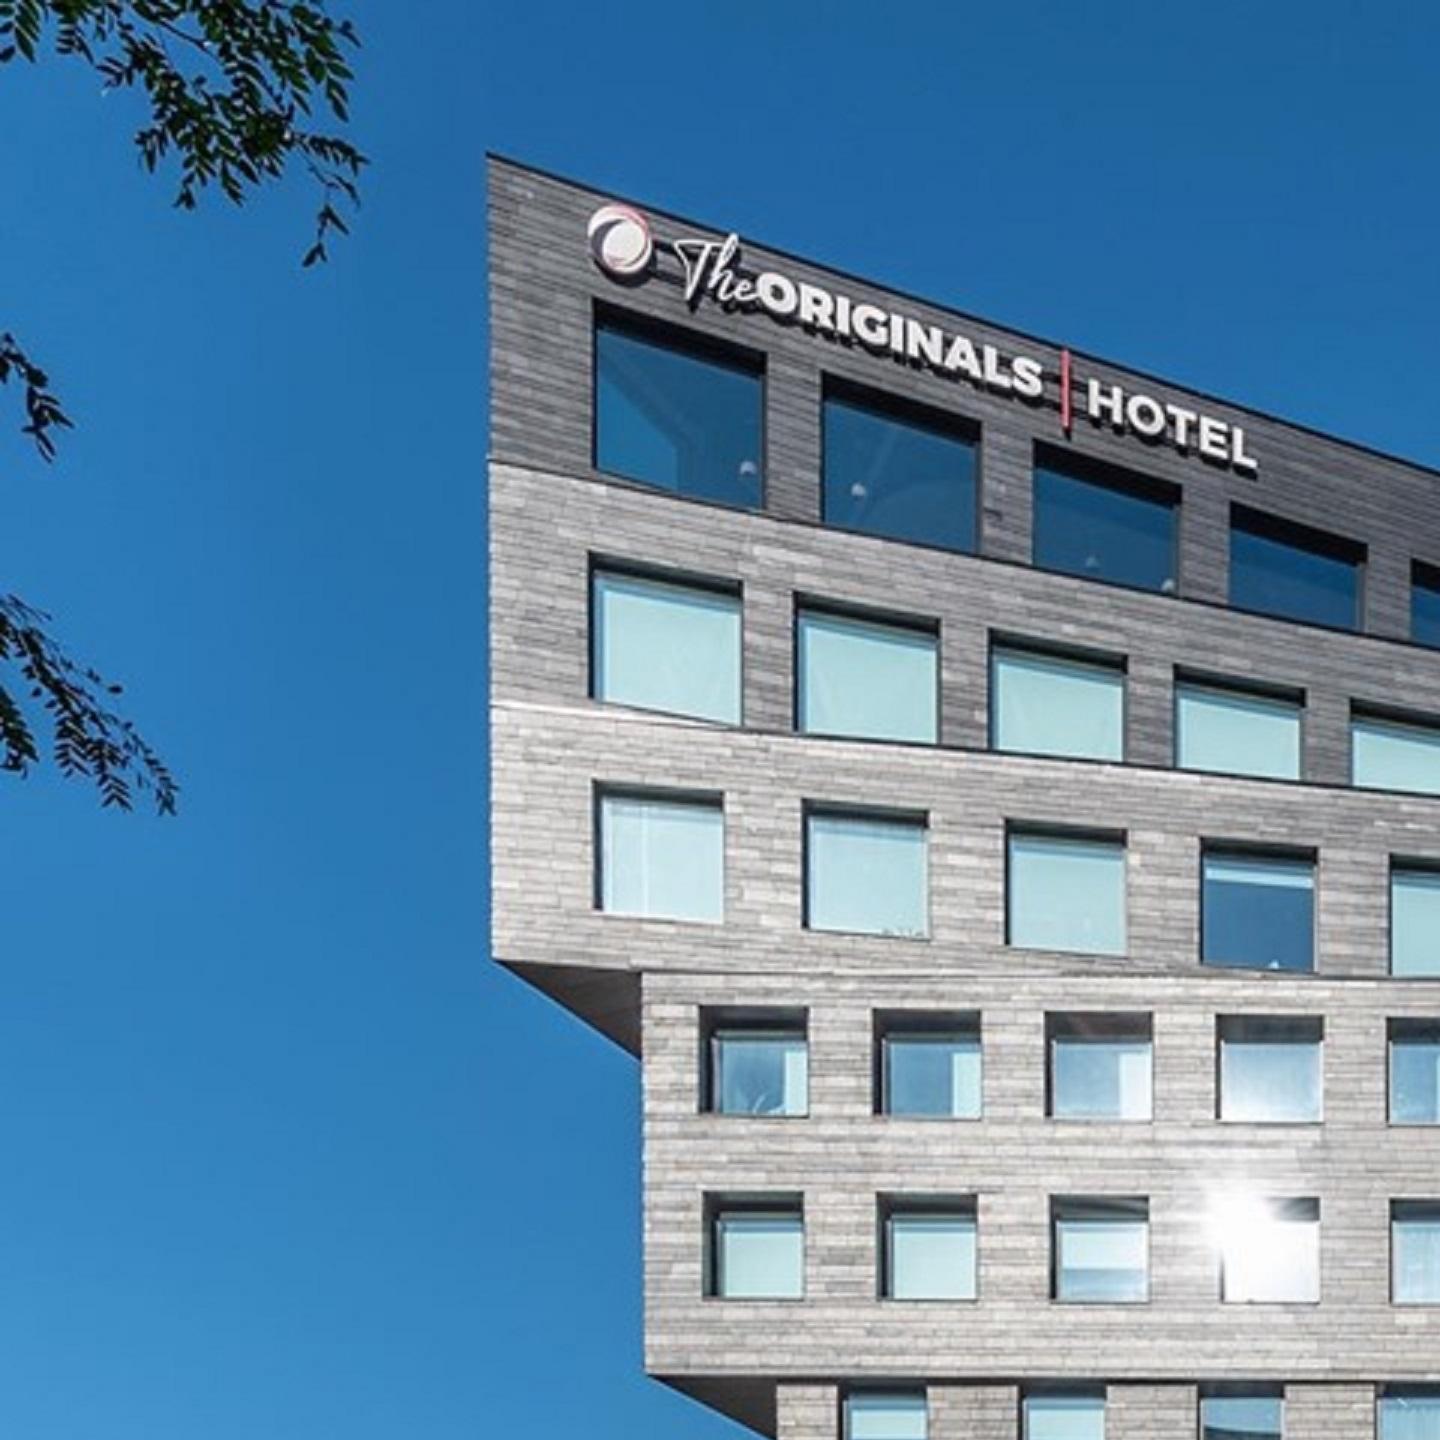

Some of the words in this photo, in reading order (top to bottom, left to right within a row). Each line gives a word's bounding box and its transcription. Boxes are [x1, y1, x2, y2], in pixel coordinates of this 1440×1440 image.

[674, 232, 760, 301] The
[756, 272, 1044, 397] ORIGINALS
[1087, 379, 1259, 469] HOTEL
